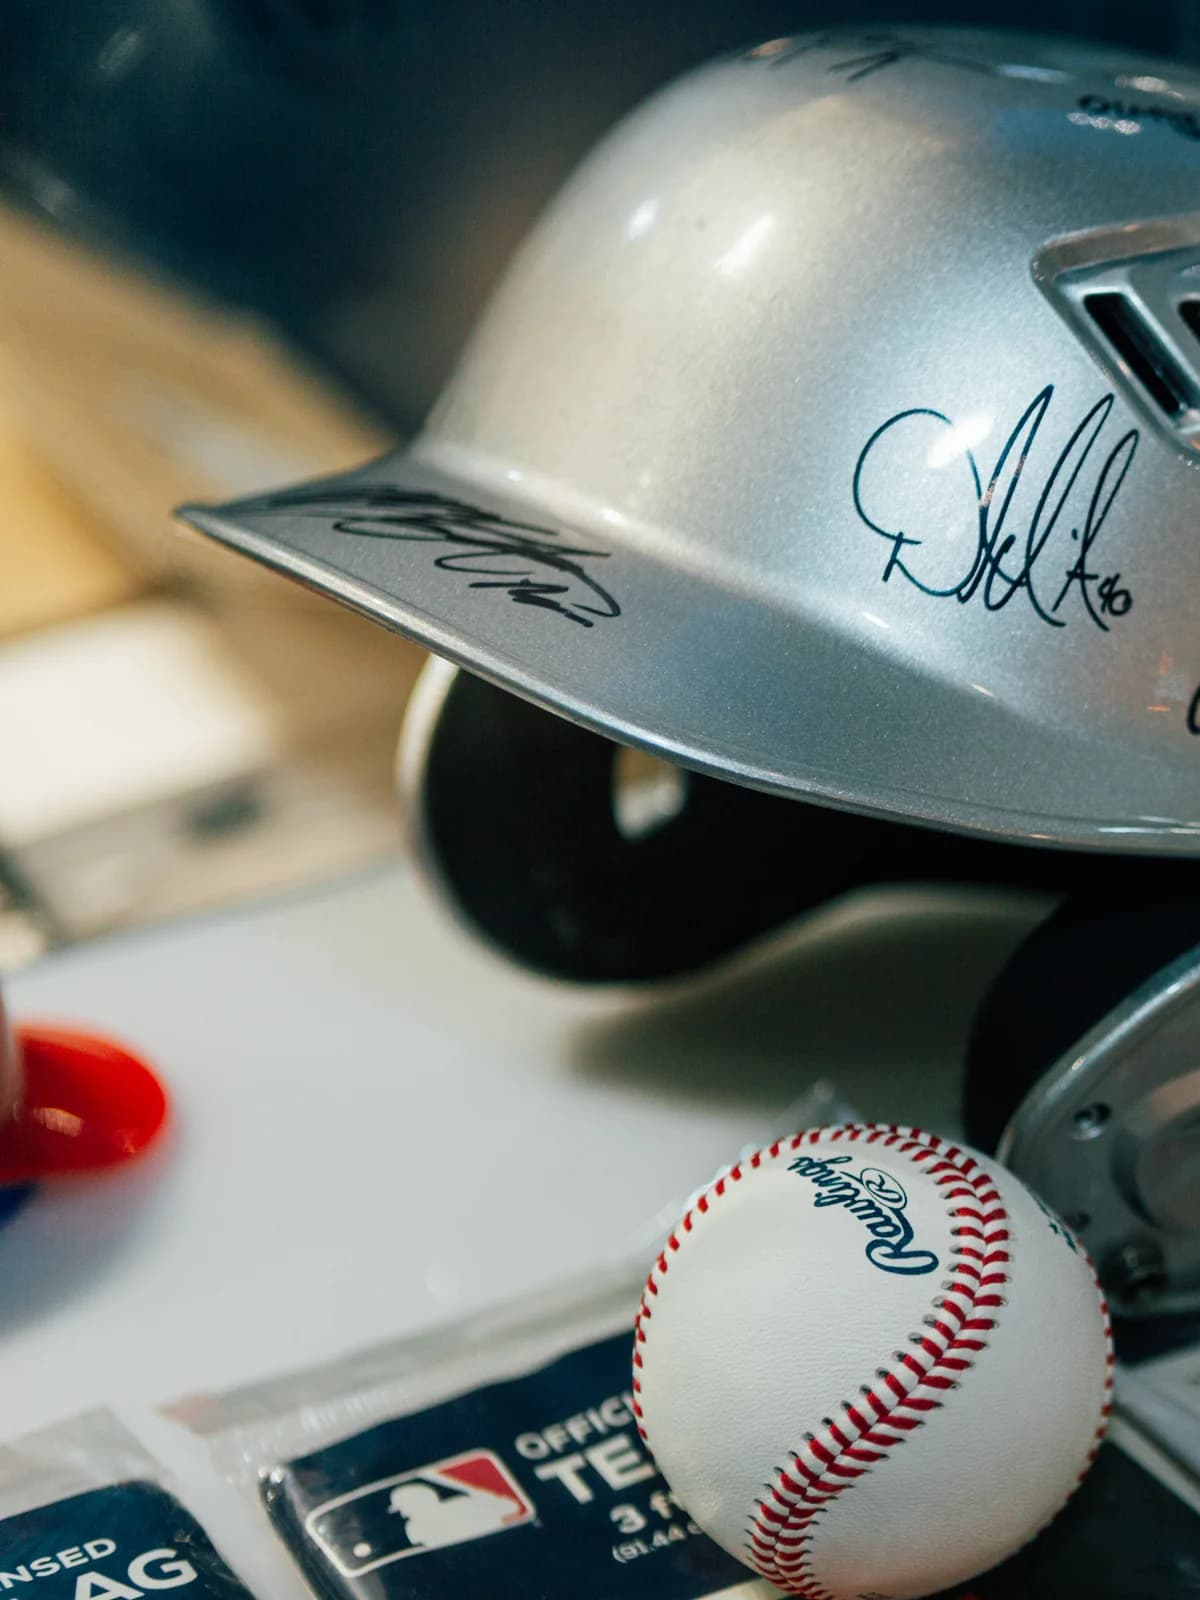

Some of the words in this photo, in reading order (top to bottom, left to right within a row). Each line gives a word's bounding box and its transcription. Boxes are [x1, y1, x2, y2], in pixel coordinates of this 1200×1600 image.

[786, 1155, 940, 1276] Rawlings
[533, 1433, 656, 1505] TE
[610, 1504, 647, 1534] 3
[0, 1537, 117, 1592] NSED
[73, 1548, 198, 1600] AG
